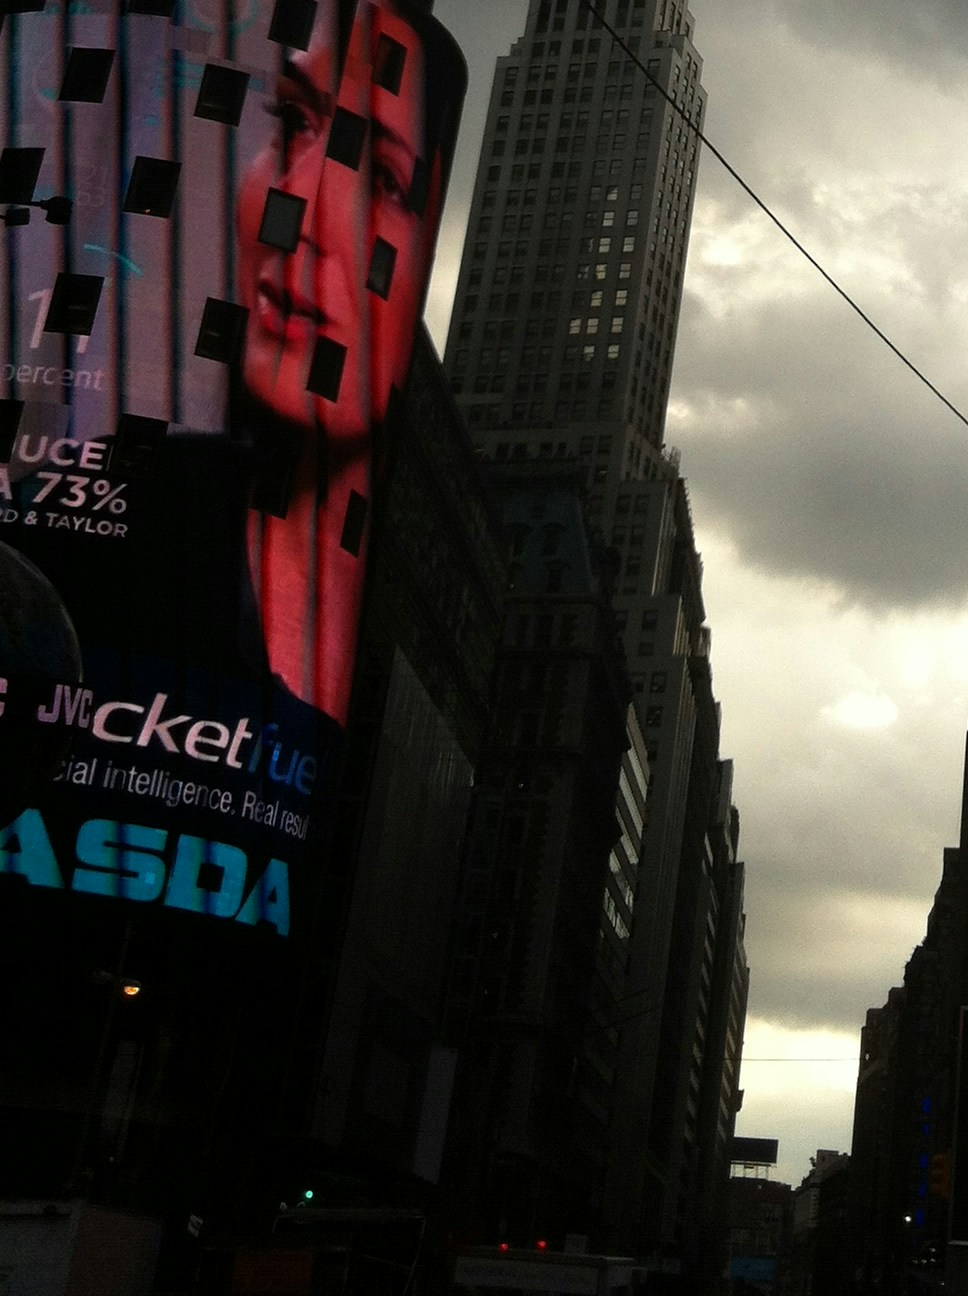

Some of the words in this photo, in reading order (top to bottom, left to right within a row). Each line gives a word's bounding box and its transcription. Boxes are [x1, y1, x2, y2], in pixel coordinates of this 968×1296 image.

[32, 471, 128, 515] 73%
[23, 509, 39, 526] &
[45, 511, 129, 538] TAYLOR
[37, 683, 94, 729] JVC
[103, 760, 236, 816] intelligence.
[241, 789, 280, 827] Real
